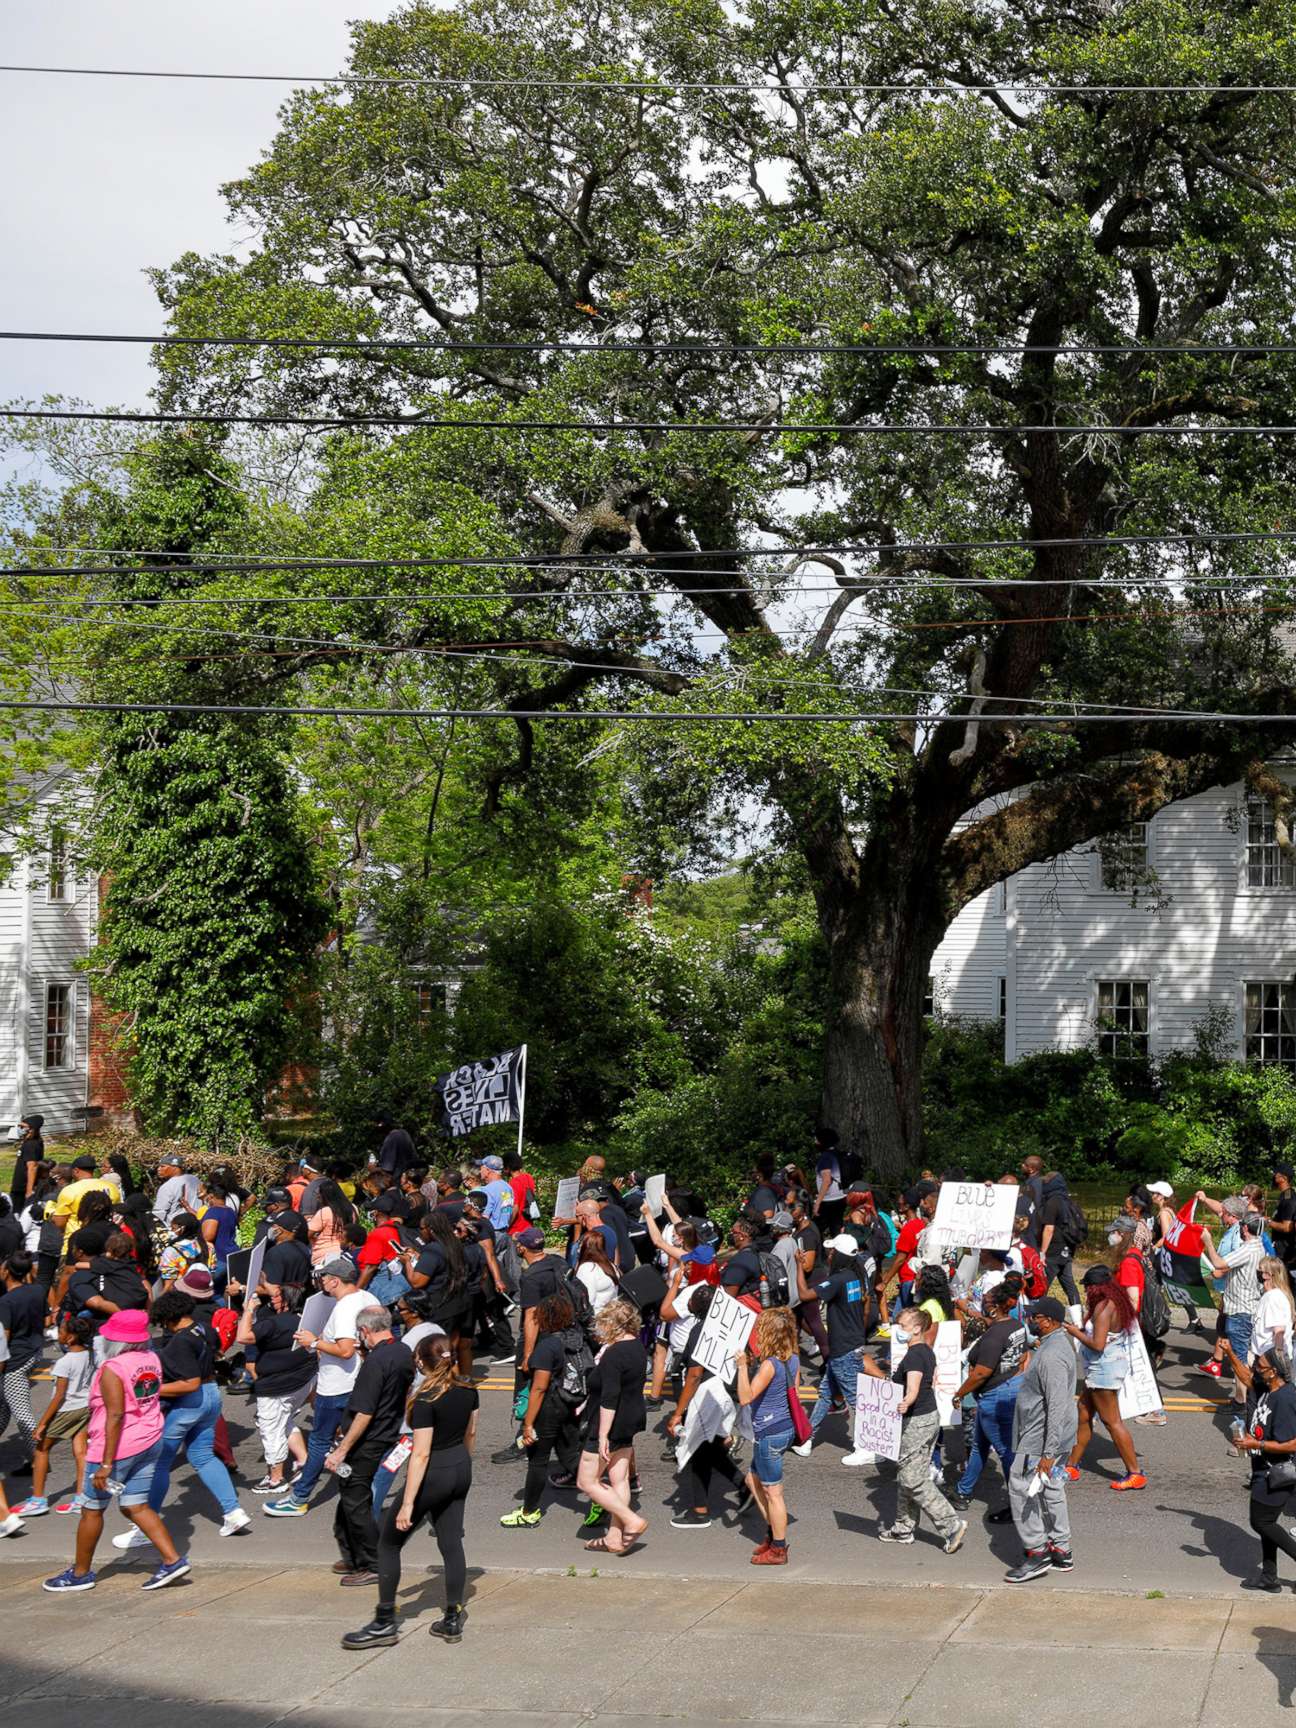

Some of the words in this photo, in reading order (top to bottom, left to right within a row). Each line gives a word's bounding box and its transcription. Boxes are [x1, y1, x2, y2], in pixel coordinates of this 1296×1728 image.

[710, 1290, 750, 1341] BLM
[695, 1331, 736, 1379] MLK
[857, 1393, 881, 1416] Good
[871, 1378, 894, 1401] NO
